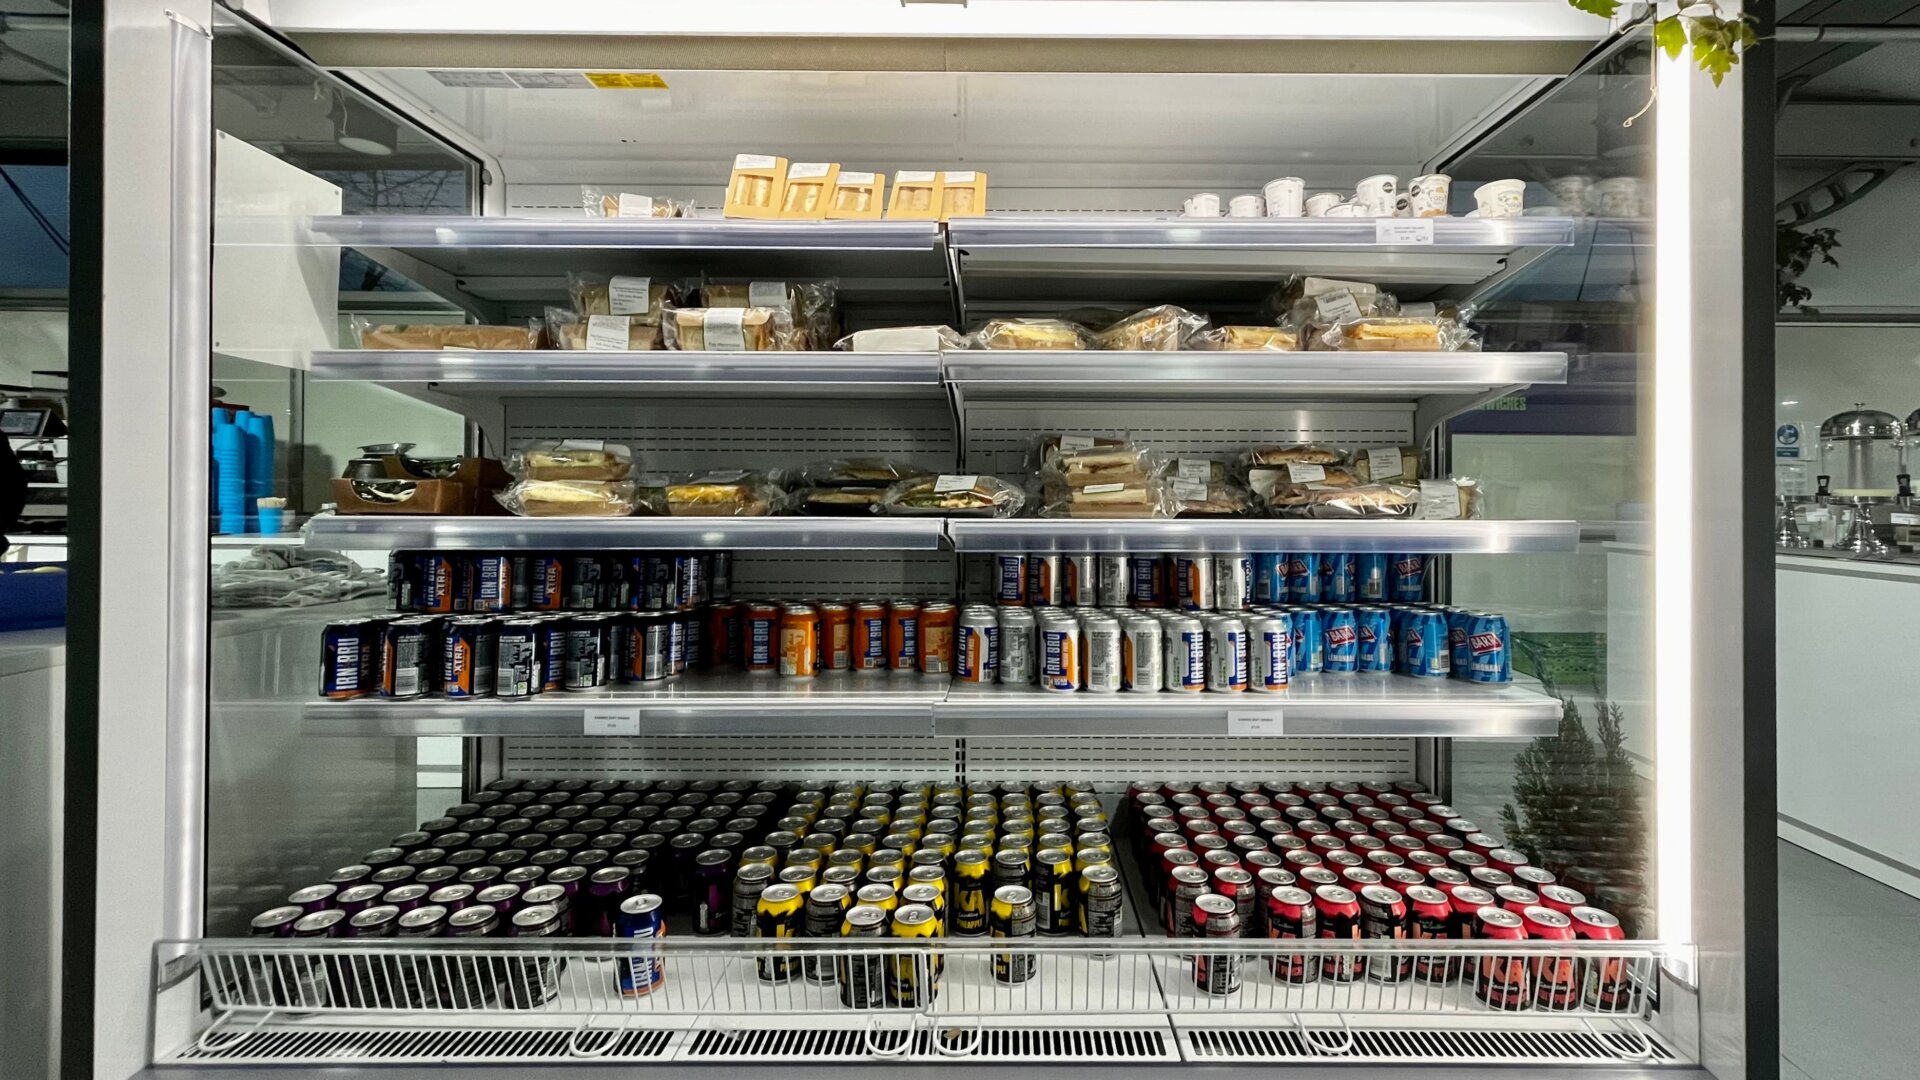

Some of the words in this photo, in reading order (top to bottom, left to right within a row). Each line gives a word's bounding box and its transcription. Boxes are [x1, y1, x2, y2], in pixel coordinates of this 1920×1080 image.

[436, 567, 446, 597] XTRA
[546, 566, 557, 595] XTRA
[1329, 626, 1355, 642] BARR
[1471, 635, 1498, 649] BARR
[453, 645, 464, 674] XTRA
[1328, 654, 1355, 662] LEMONADE
[1471, 663, 1502, 672] LEMONADE
[957, 919, 982, 929] PINEAPPLE
